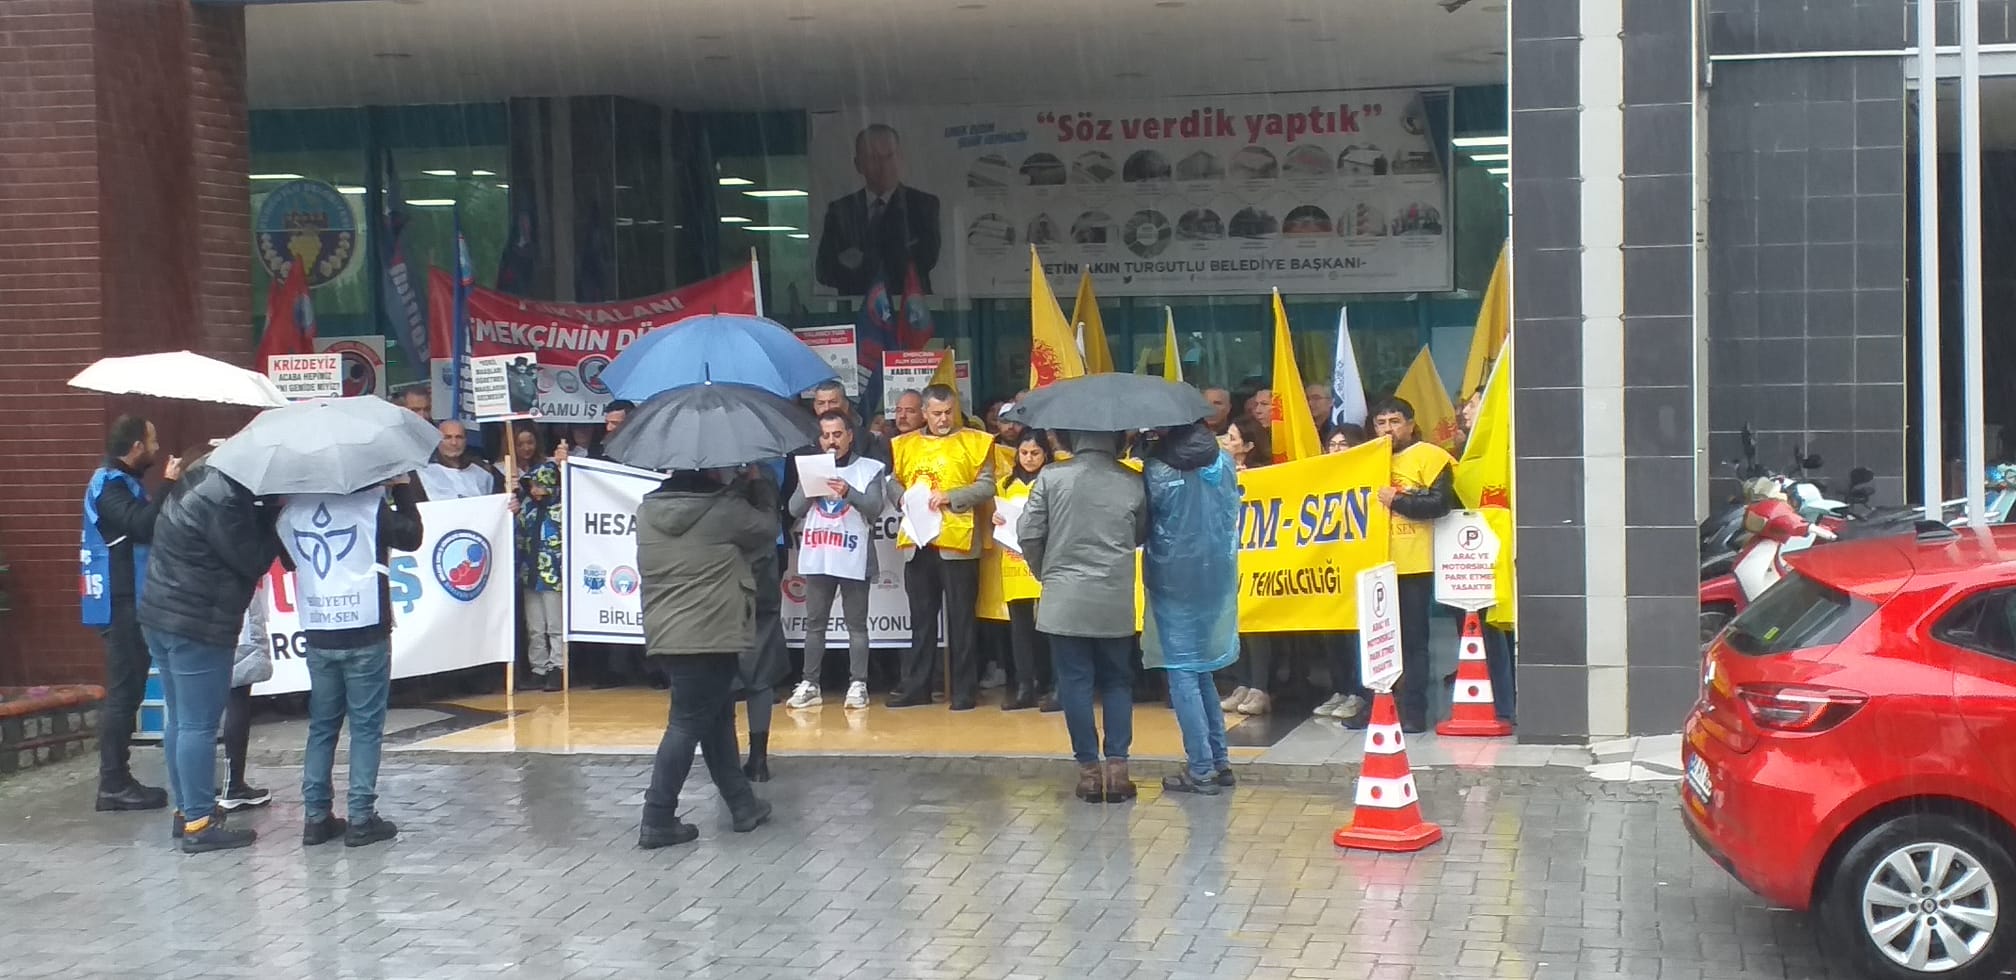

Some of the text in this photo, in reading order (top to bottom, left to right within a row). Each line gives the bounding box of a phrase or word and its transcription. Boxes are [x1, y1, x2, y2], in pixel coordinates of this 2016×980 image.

[1120, 107, 1236, 139] verdik
[1124, 260, 1205, 273] TURGUTLU
[1210, 256, 1286, 271] BELEDİYE
[576, 296, 685, 323] YALANI
[471, 319, 609, 350] MEKÇİNİN
[273, 355, 337, 371] KRİZDEYİZ
[279, 373, 301, 381] ACABA
[539, 402, 582, 416] KAMU
[584, 401, 598, 418] İŞ
[584, 512, 637, 535] HESA
[1237, 484, 1372, 549] İM-SEN
[1452, 553, 1476, 561] ARAÇ
[599, 606, 643, 625] BİRLE
